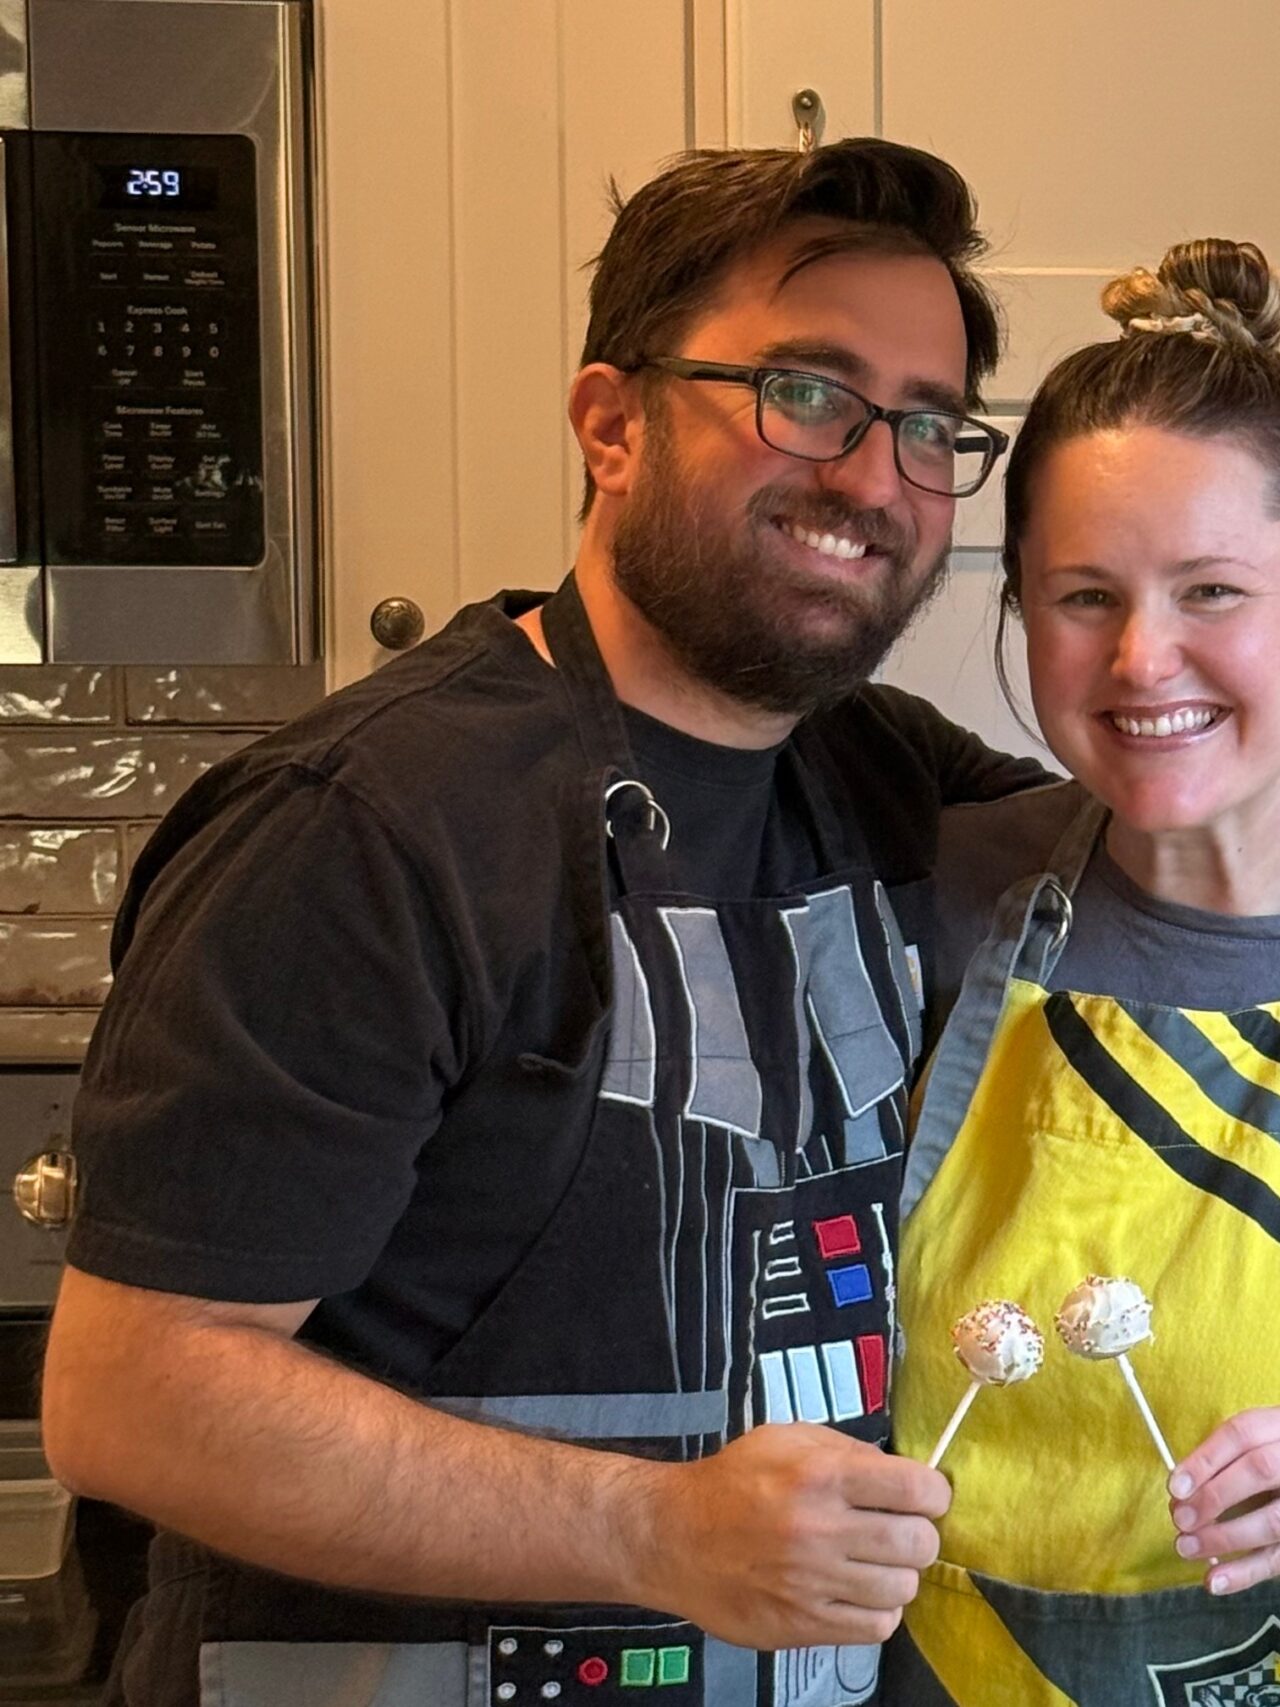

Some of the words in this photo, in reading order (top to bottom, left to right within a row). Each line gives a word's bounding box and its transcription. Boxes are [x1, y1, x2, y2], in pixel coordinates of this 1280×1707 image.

[114, 222, 146, 233] Sensor
[148, 223, 196, 233] Microwave
[92, 239, 124, 249] Popcorn
[138, 240, 173, 250] Beverage
[191, 241, 216, 250] Potato
[127, 305, 163, 316] Express
[164, 306, 188, 316] Cook
[97, 321, 105, 333] 1
[124, 320, 134, 333] 2
[153, 322, 163, 334] 3
[180, 322, 190, 333] 4
[209, 322, 218, 335] 5
[97, 345, 107, 356] 6
[126, 345, 135, 357] 7
[154, 345, 163, 357] 8
[182, 346, 191, 358] 9
[209, 346, 219, 358] 0
[116, 406, 164, 416] Microwave
[165, 406, 204, 417] Features
